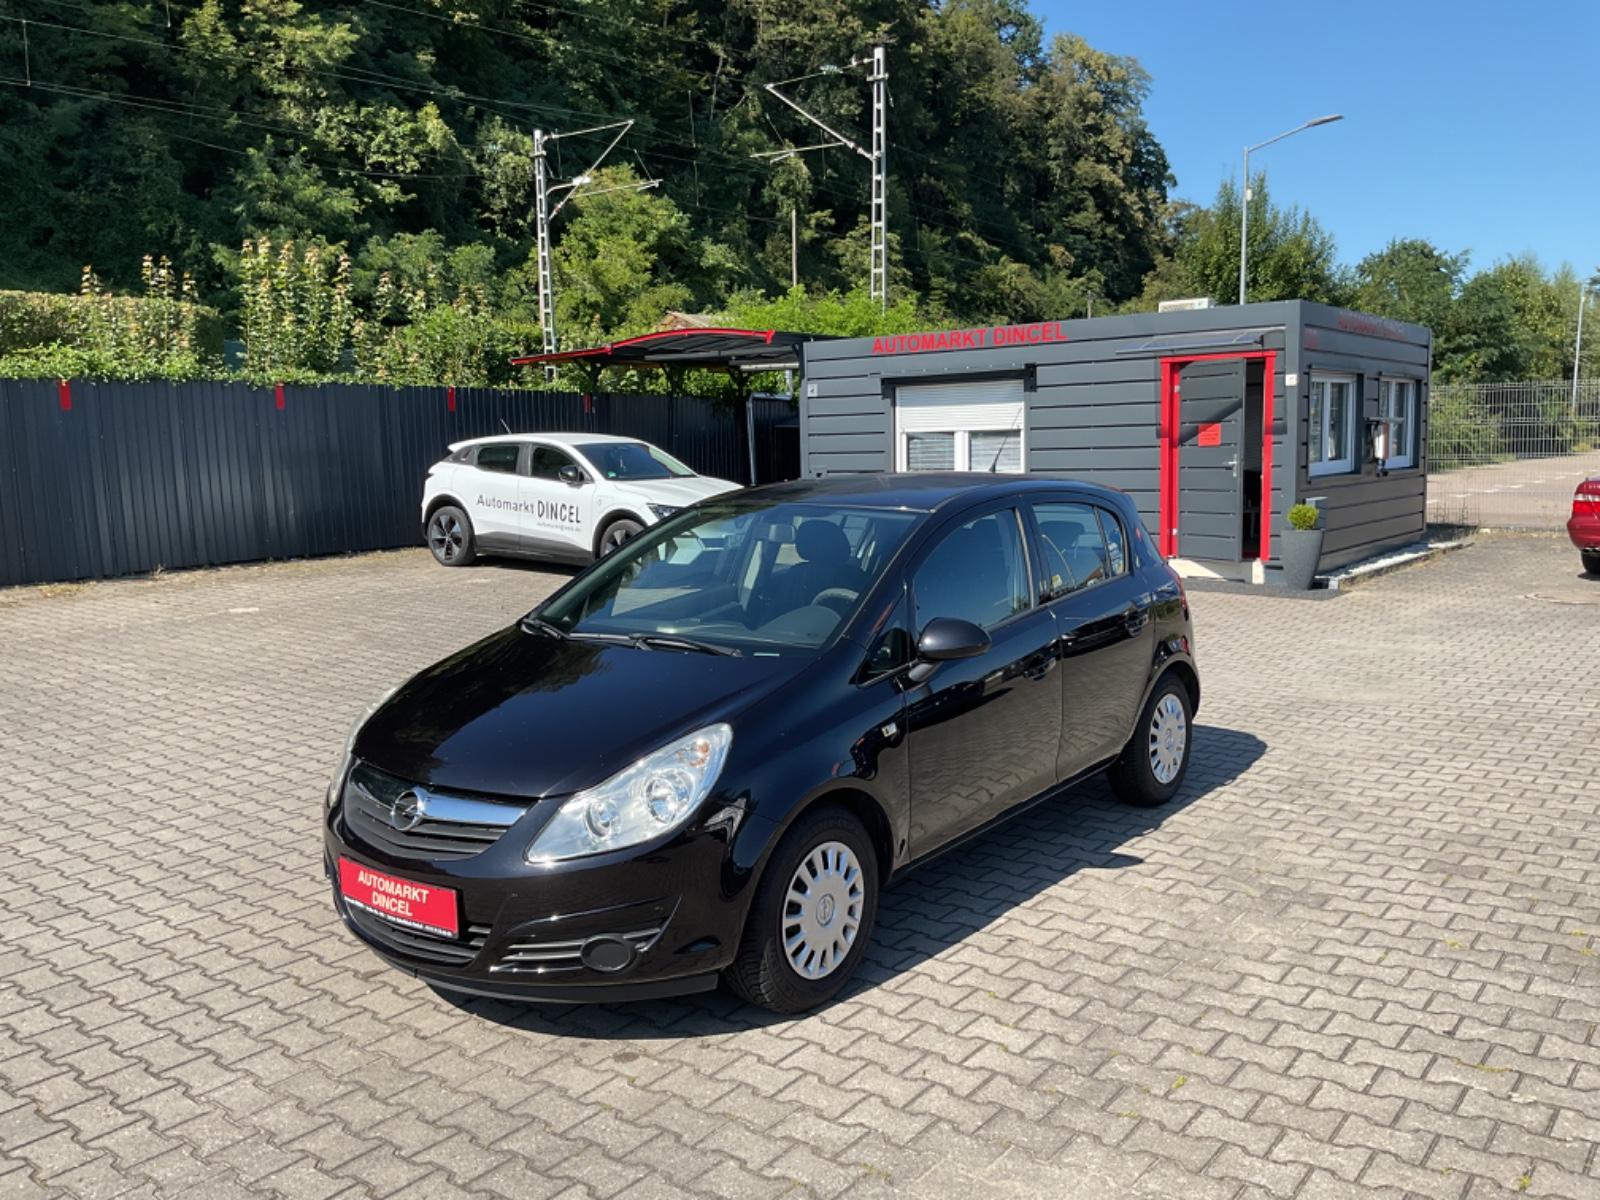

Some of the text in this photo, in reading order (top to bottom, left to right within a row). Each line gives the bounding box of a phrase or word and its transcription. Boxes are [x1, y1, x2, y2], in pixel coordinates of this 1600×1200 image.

[873, 322, 1067, 353] AUTOMARKT DINCEL
[477, 495, 581, 523] Automarkt DINCEL
[358, 871, 429, 903] AUTOMARKT
[372, 892, 412, 916] DINCEL
